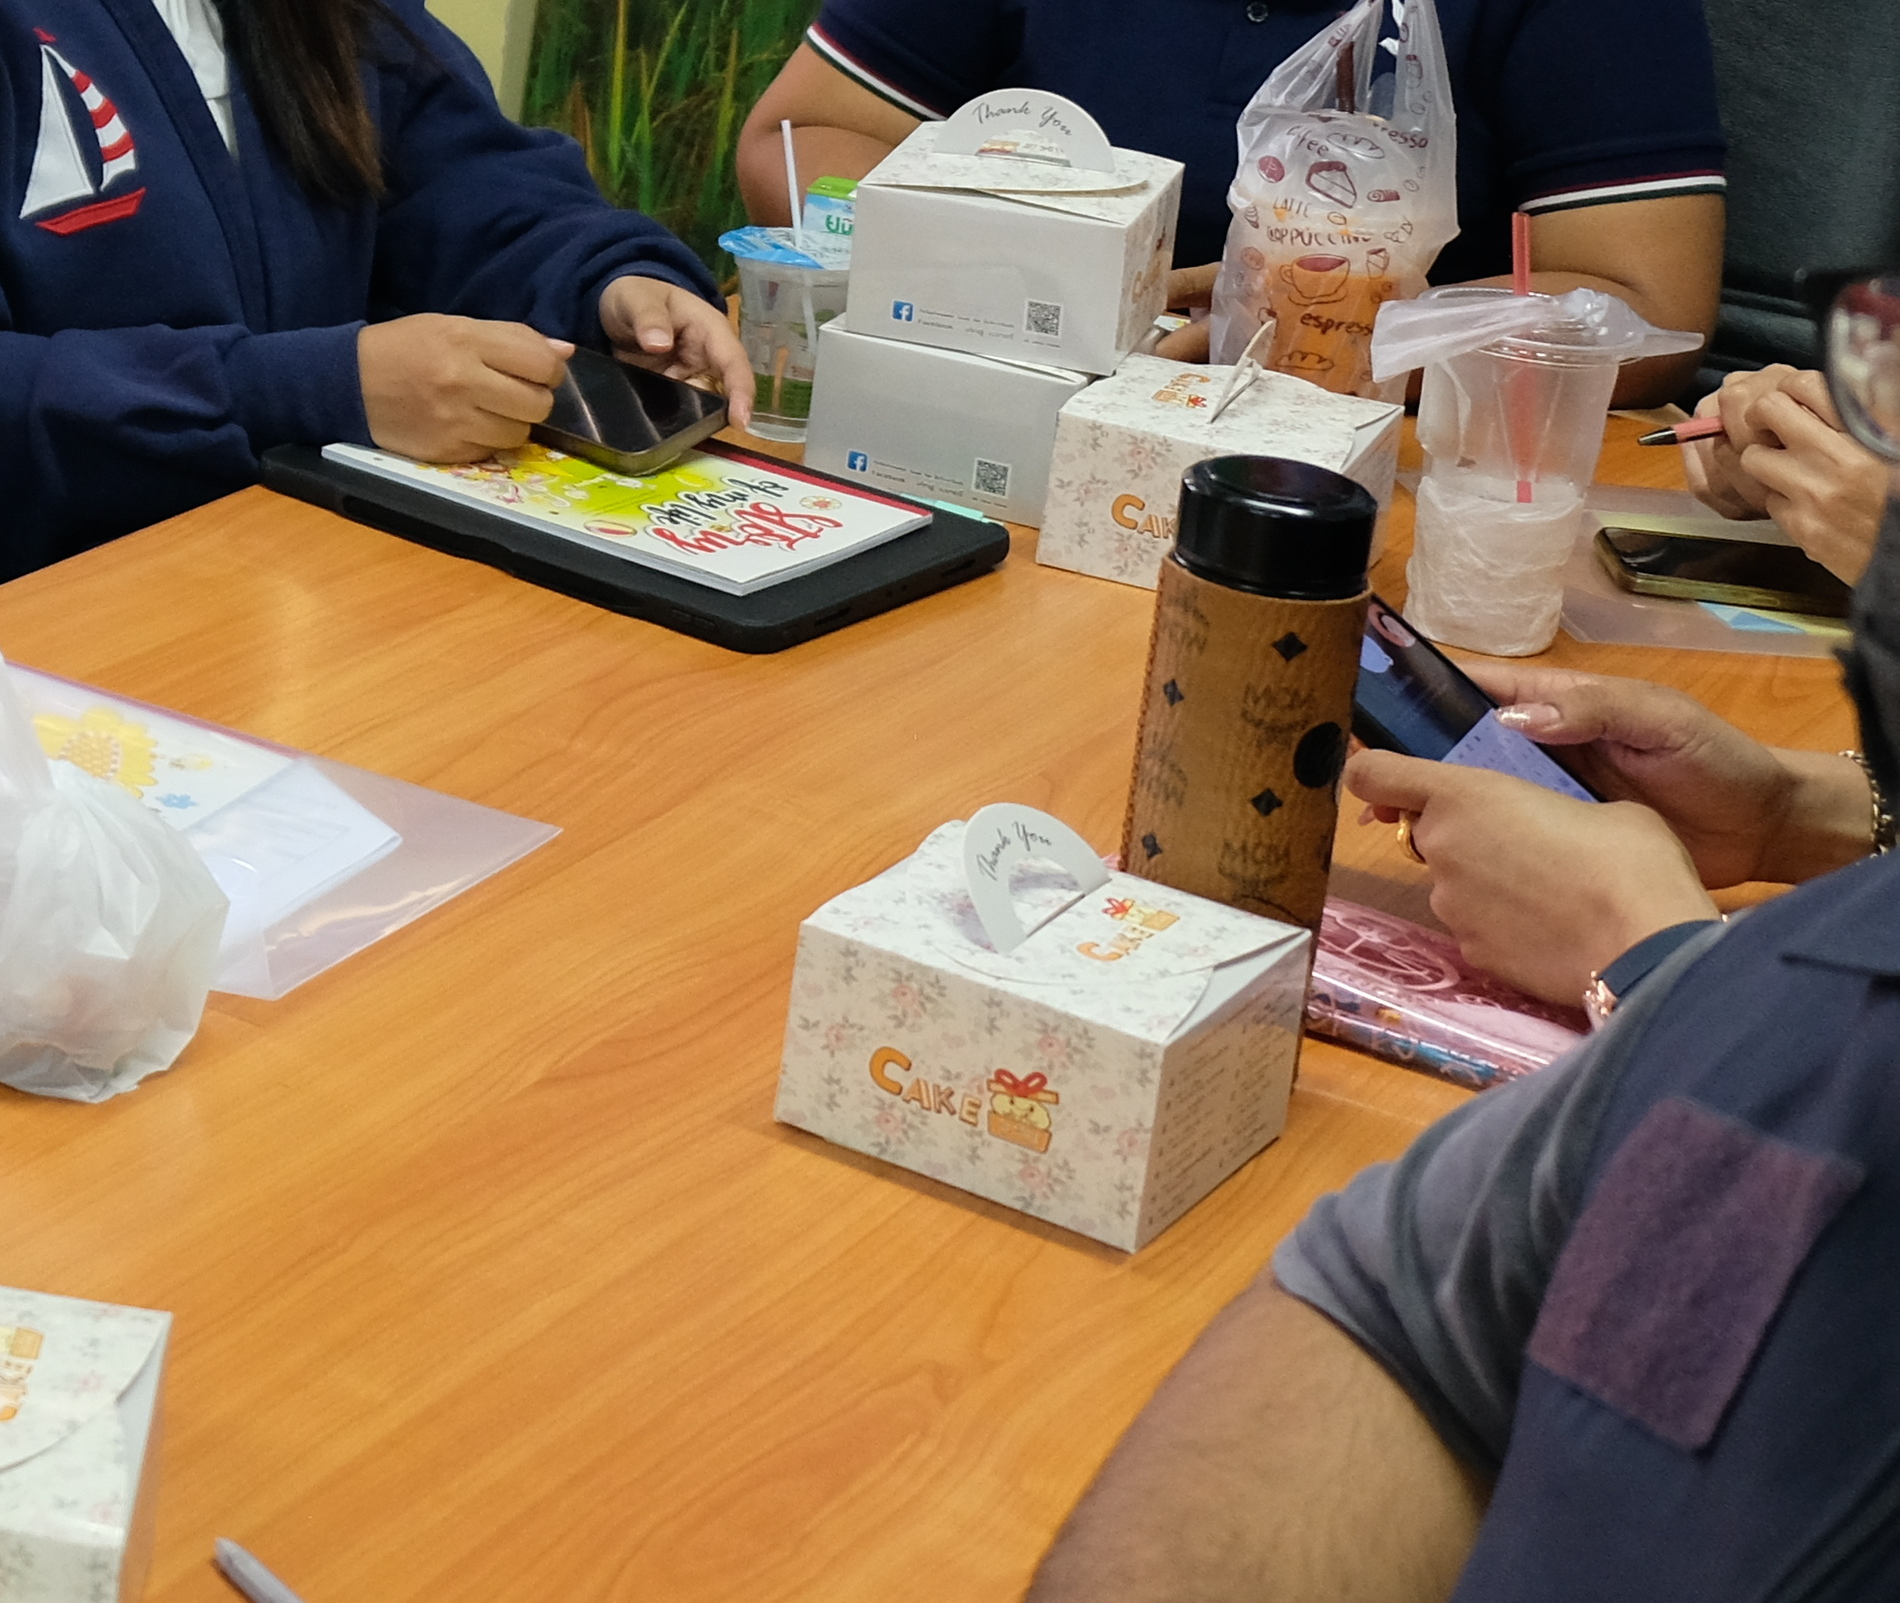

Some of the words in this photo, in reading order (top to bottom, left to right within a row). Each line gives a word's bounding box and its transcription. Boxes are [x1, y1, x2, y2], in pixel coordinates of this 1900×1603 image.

[972, 100, 1032, 125] Thank
[1038, 106, 1073, 138] You
[1300, 312, 1373, 335] espress
[1111, 493, 1178, 539] CAK
[868, 1045, 983, 1127] CAKE
